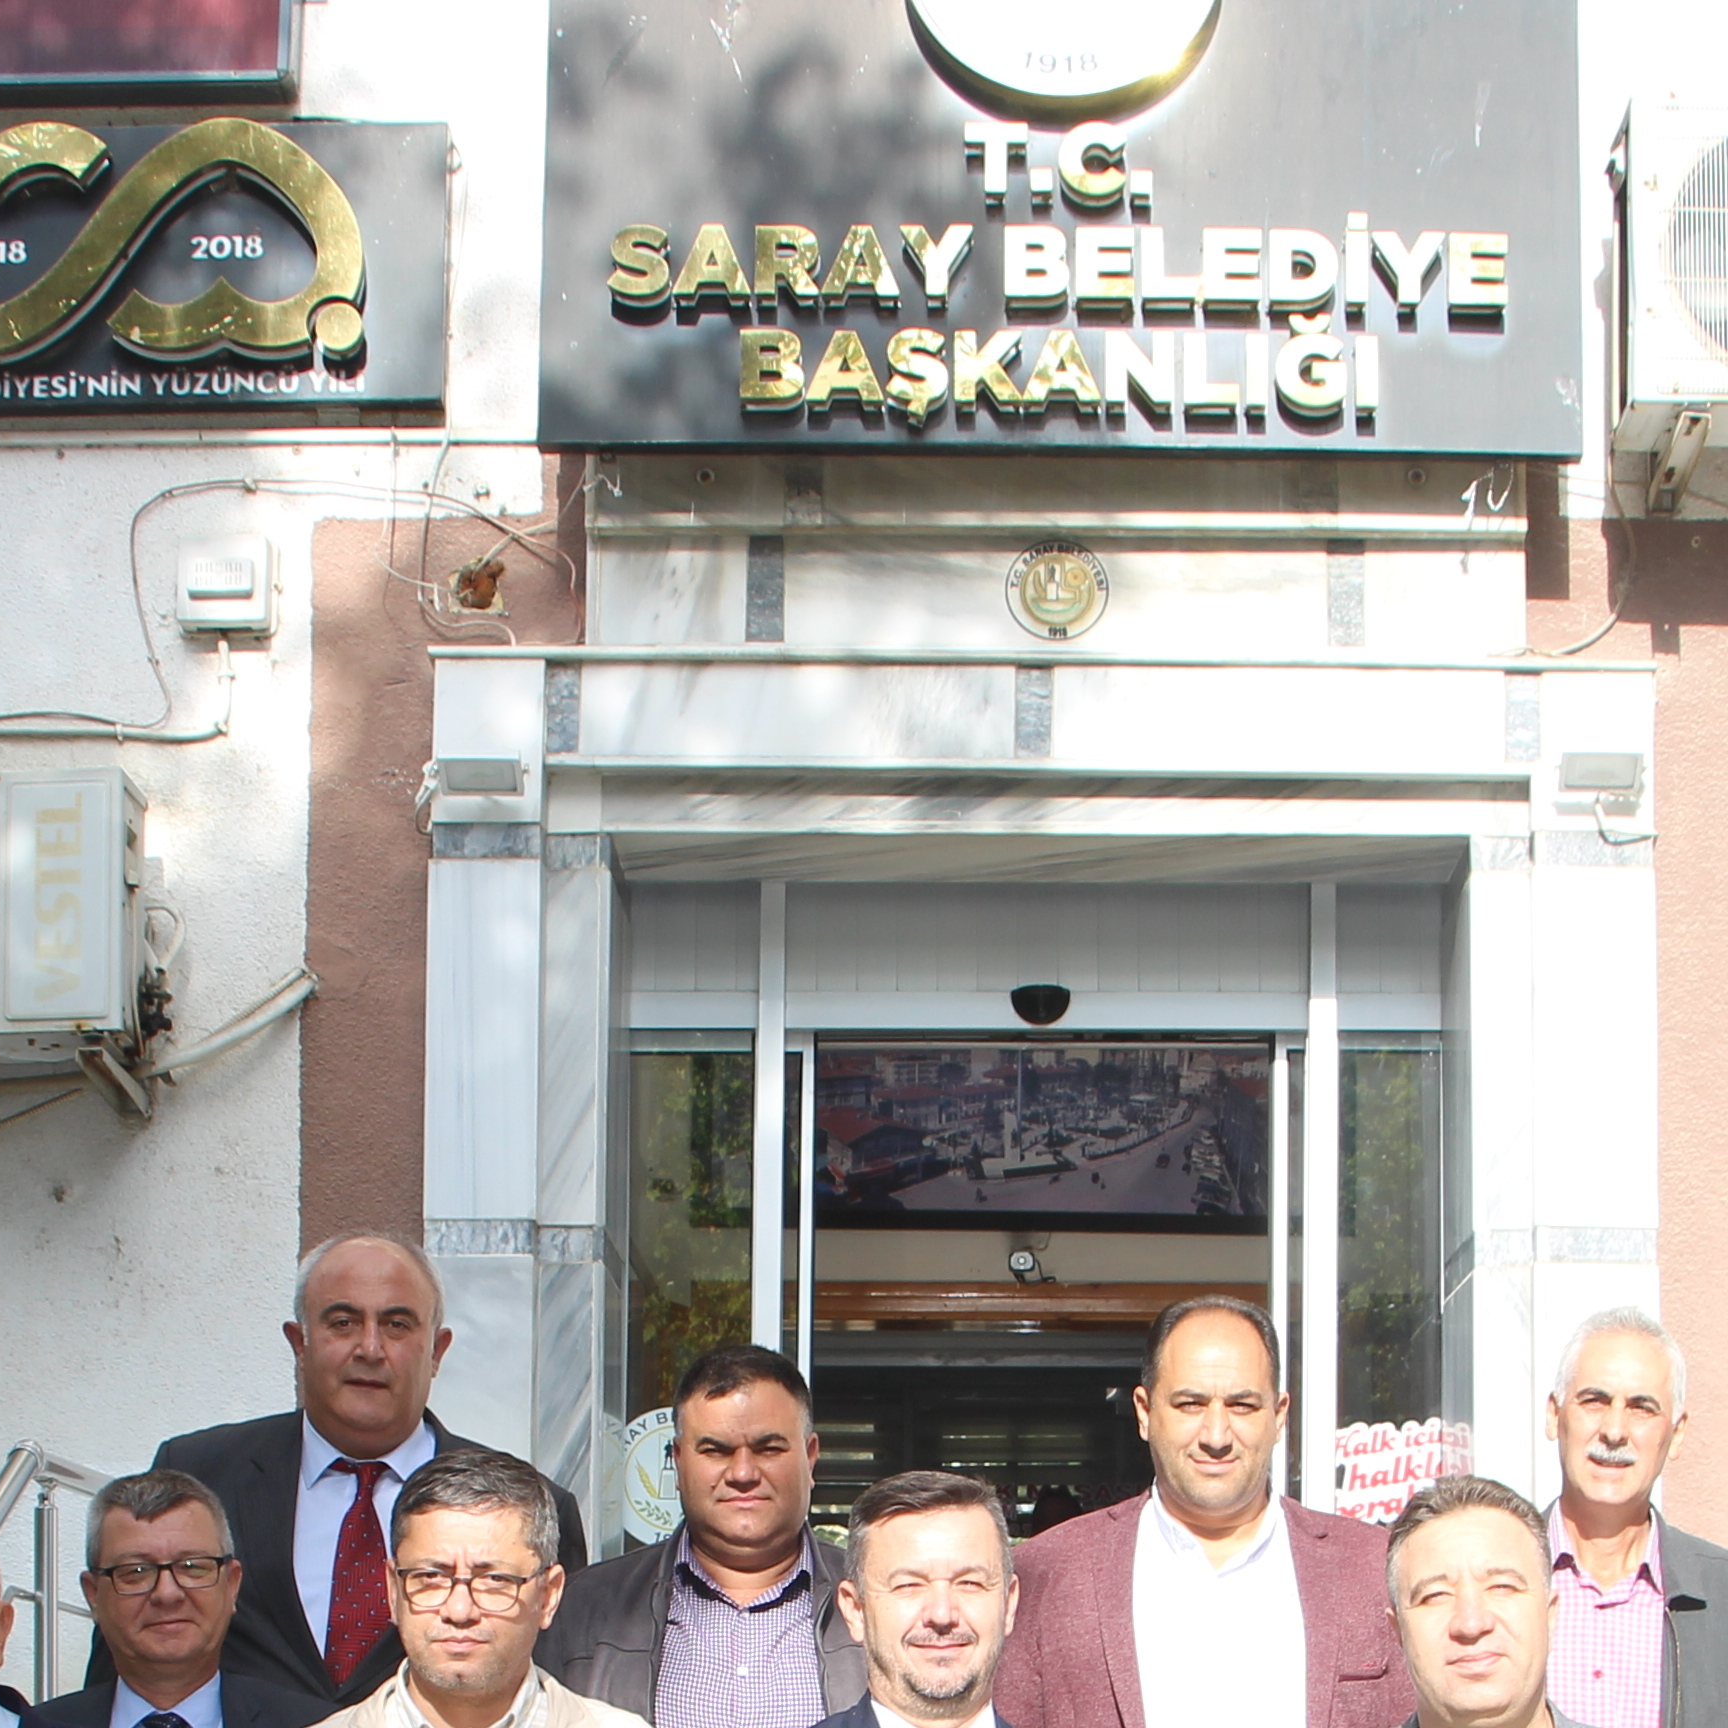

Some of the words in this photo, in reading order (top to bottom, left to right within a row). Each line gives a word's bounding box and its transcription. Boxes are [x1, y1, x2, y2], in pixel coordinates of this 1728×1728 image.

[1024, 51, 1099, 73] 1918
[964, 120, 1153, 202] T.C.
[190, 235, 264, 260] 2018
[608, 223, 973, 309] SARAY
[1004, 212, 1509, 312] BELEDİYE
[151, 366, 299, 396] YÜZÜNCÜ
[739, 312, 1380, 429] BAŞKANLIĞI
[1022, 543, 1056, 567] SARAY
[1047, 626, 1068, 639] 1918
[34, 793, 83, 1004] VESTEL
[1336, 1429, 1397, 1459] Halk
